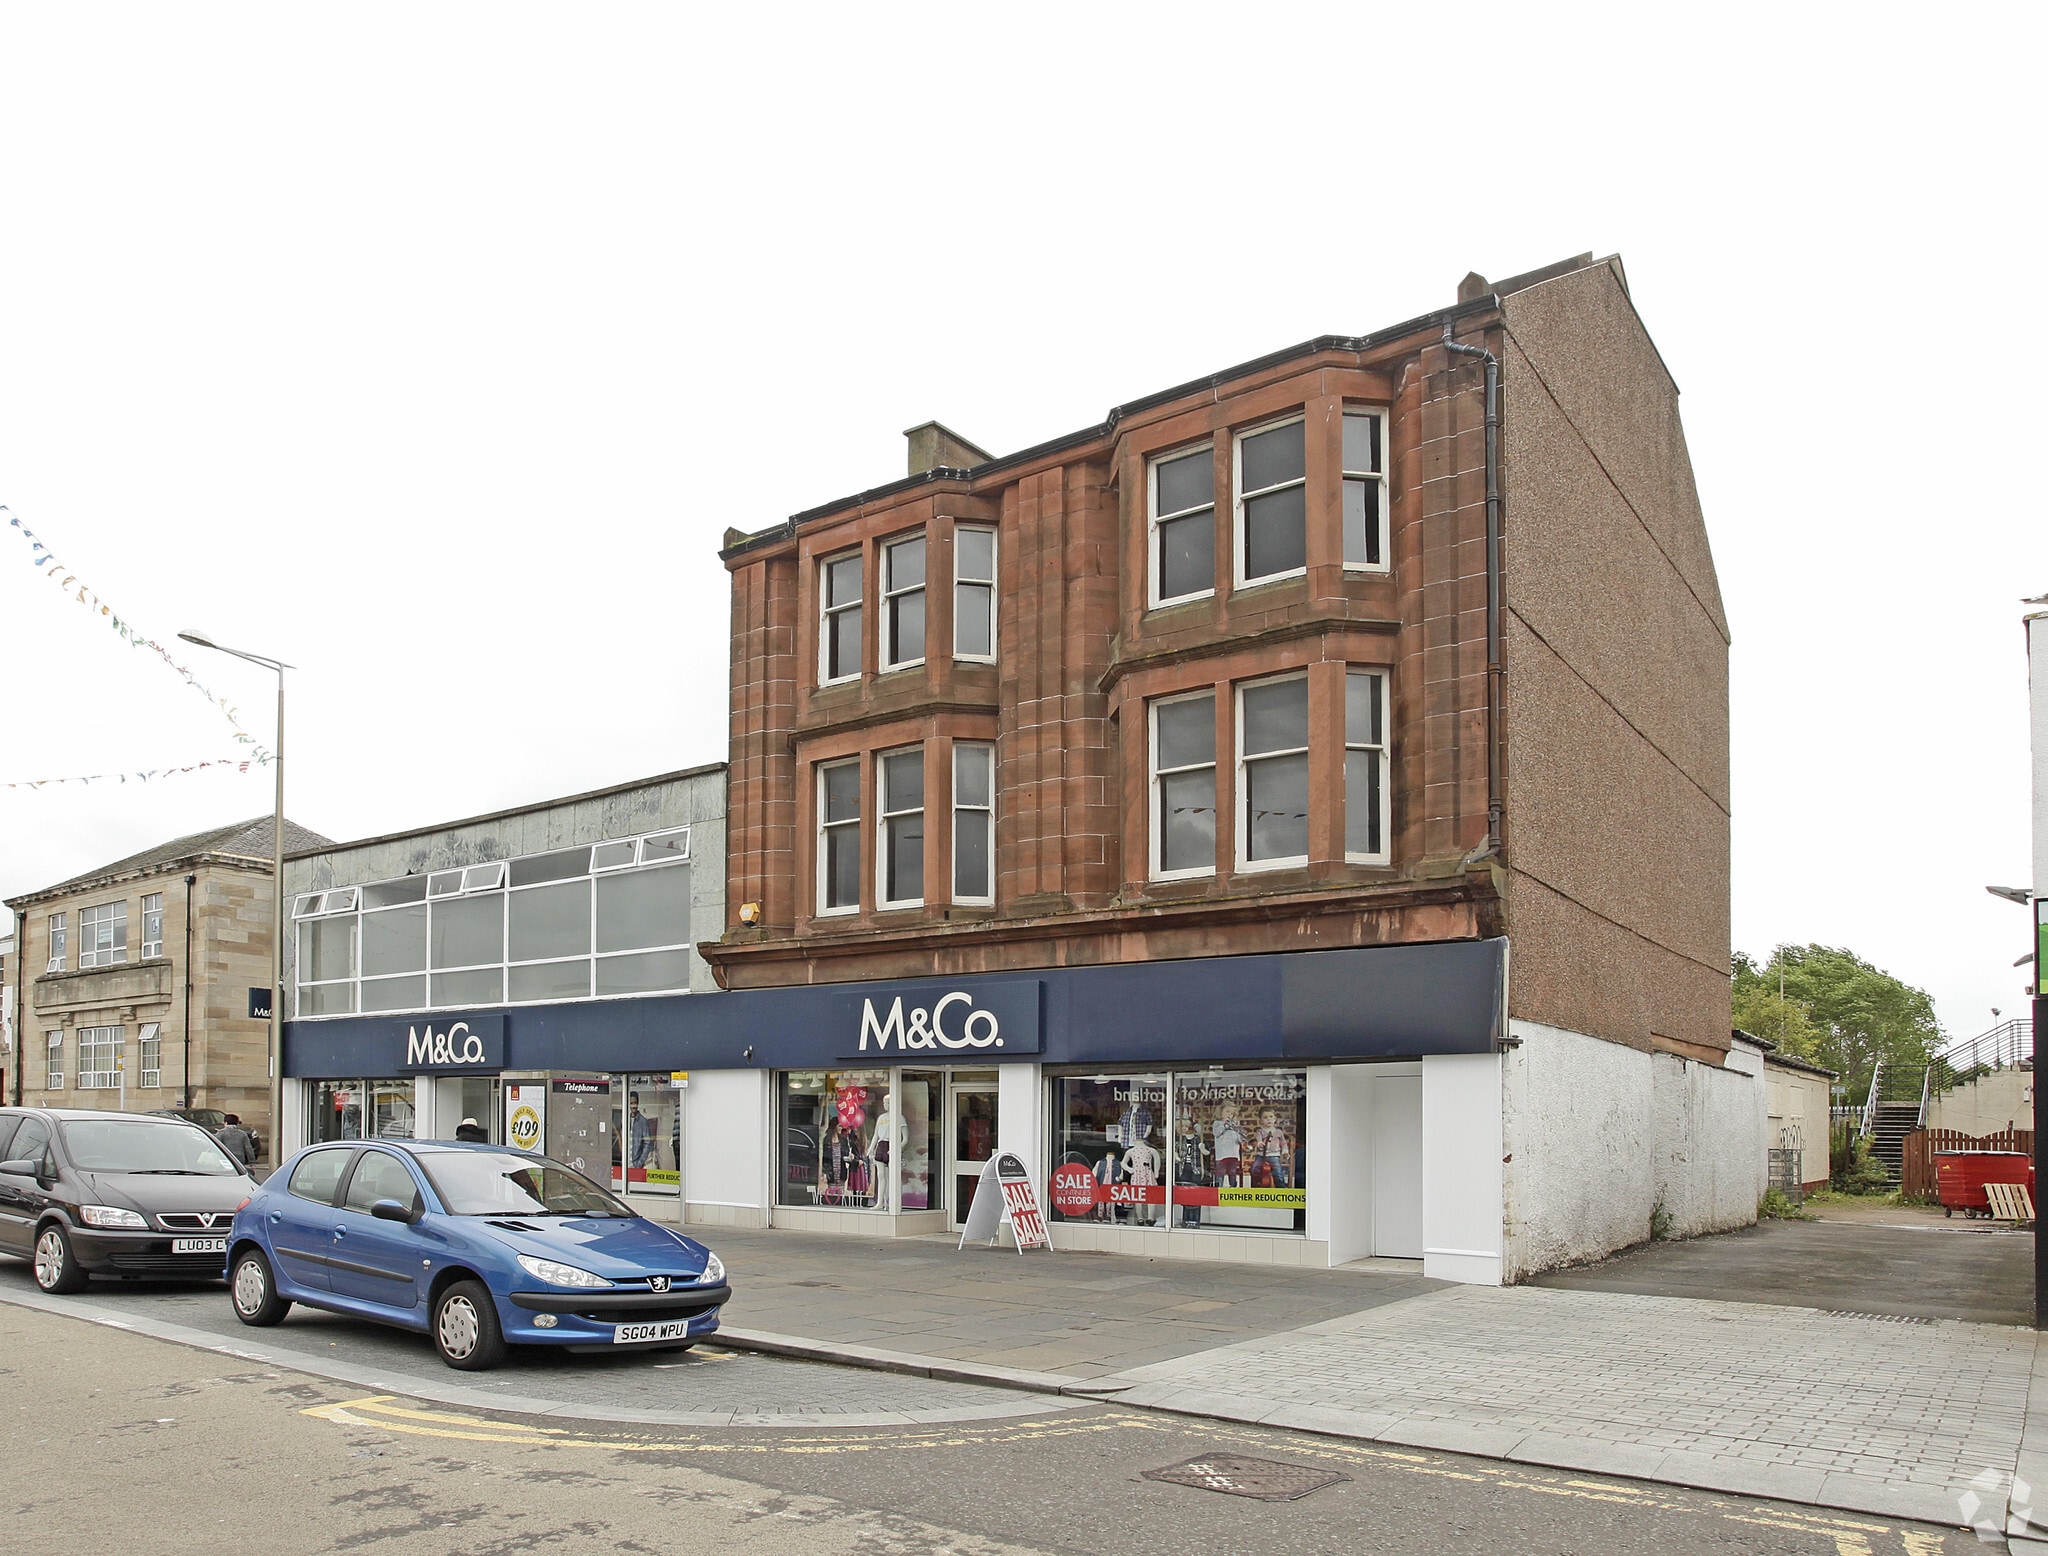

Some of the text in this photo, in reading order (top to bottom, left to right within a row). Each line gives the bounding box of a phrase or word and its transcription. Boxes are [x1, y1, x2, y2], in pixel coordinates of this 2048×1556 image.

[859, 992, 1004, 1051] M&Co.
[407, 1022, 486, 1065] M&Co.
[564, 1082, 599, 1093] Telephone
[511, 1120, 539, 1137] £1.99
[1055, 1173, 1092, 1189] SALE
[1003, 1183, 1037, 1214] SALE
[1056, 1196, 1092, 1205] IN STORE
[1110, 1186, 1147, 1202] SALE
[1219, 1193, 1306, 1203] FURTHER REDUCTIONS
[1013, 1212, 1047, 1244] SALE
[178, 1240, 213, 1251] LU03
[621, 1323, 685, 1341] SG04 WPU
